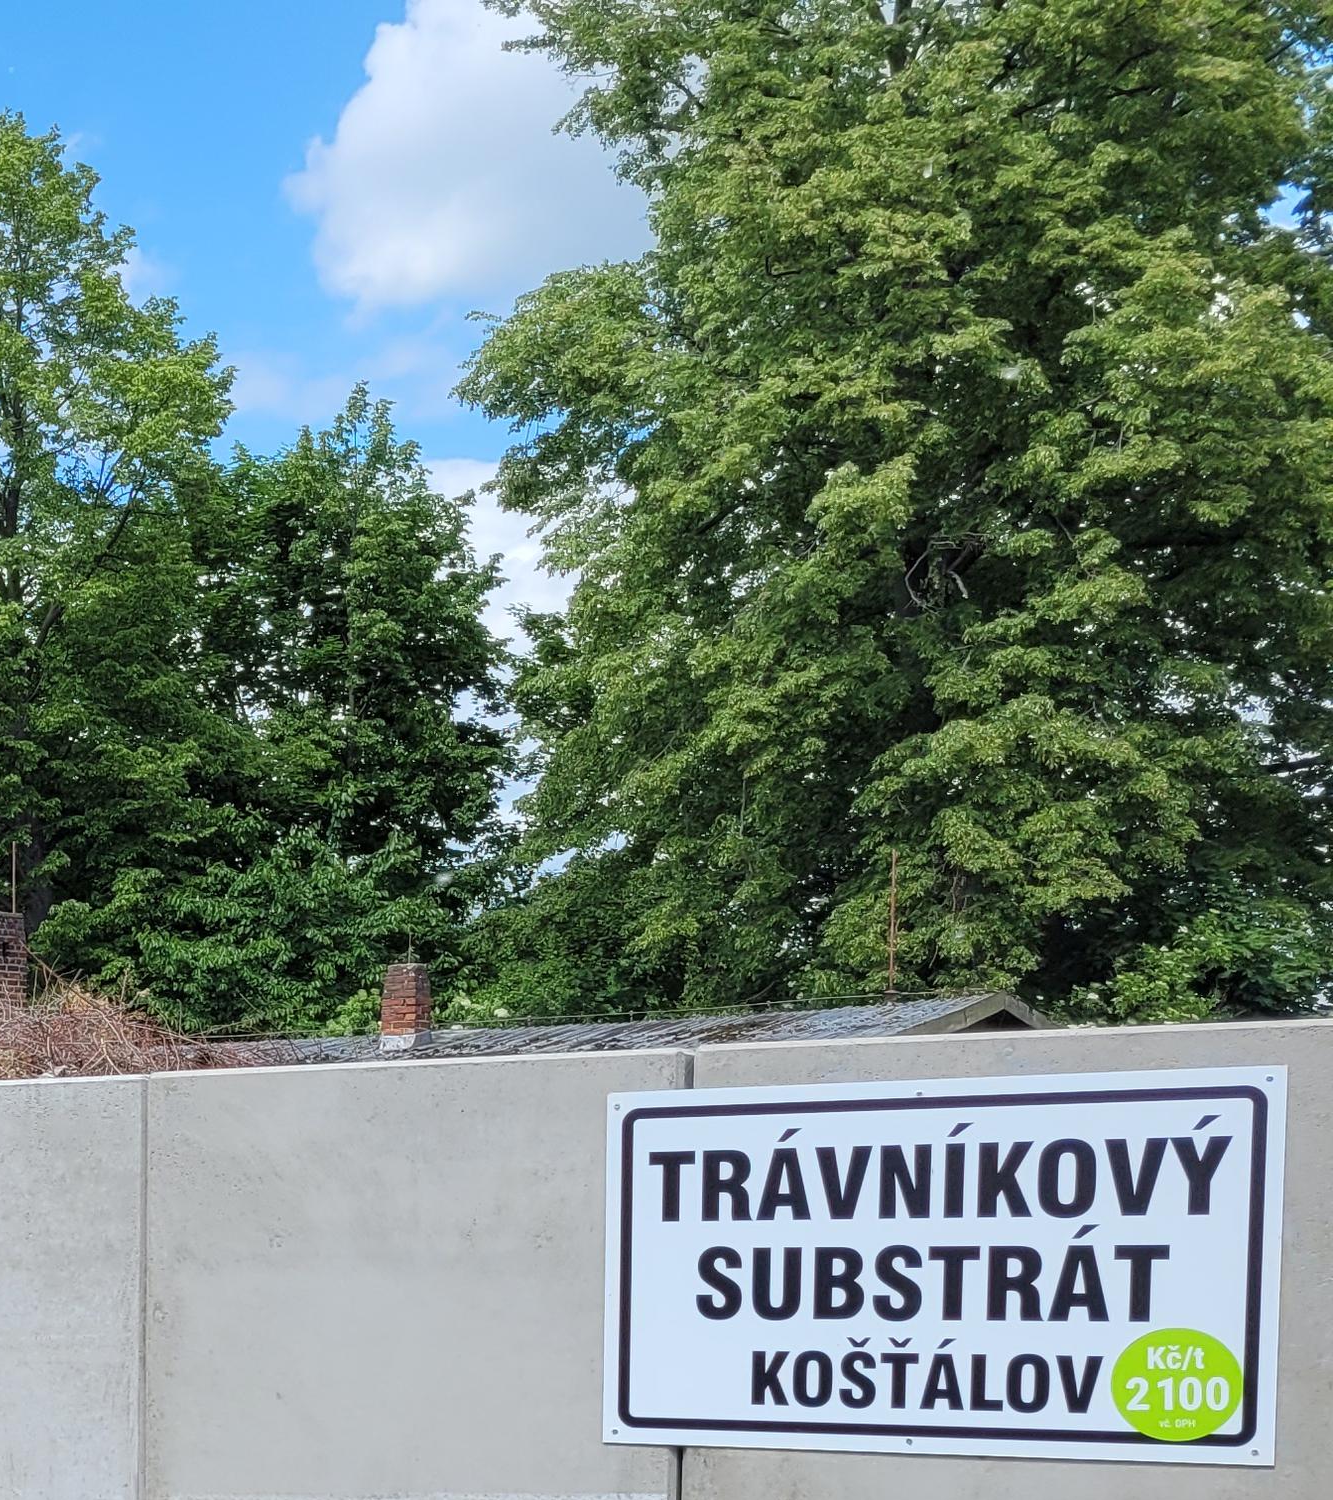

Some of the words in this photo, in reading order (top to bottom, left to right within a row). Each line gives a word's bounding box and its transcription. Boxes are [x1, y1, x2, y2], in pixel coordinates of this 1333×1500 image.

[648, 1114, 1234, 1223] TRÁVNÍKOVÝ
[695, 1224, 1171, 1323] SUBSTRÁT
[751, 1337, 1104, 1414] KOŠŤÁLOV
[1146, 1345, 1205, 1371] Kč/t
[1174, 1418, 1197, 1429] DPH
